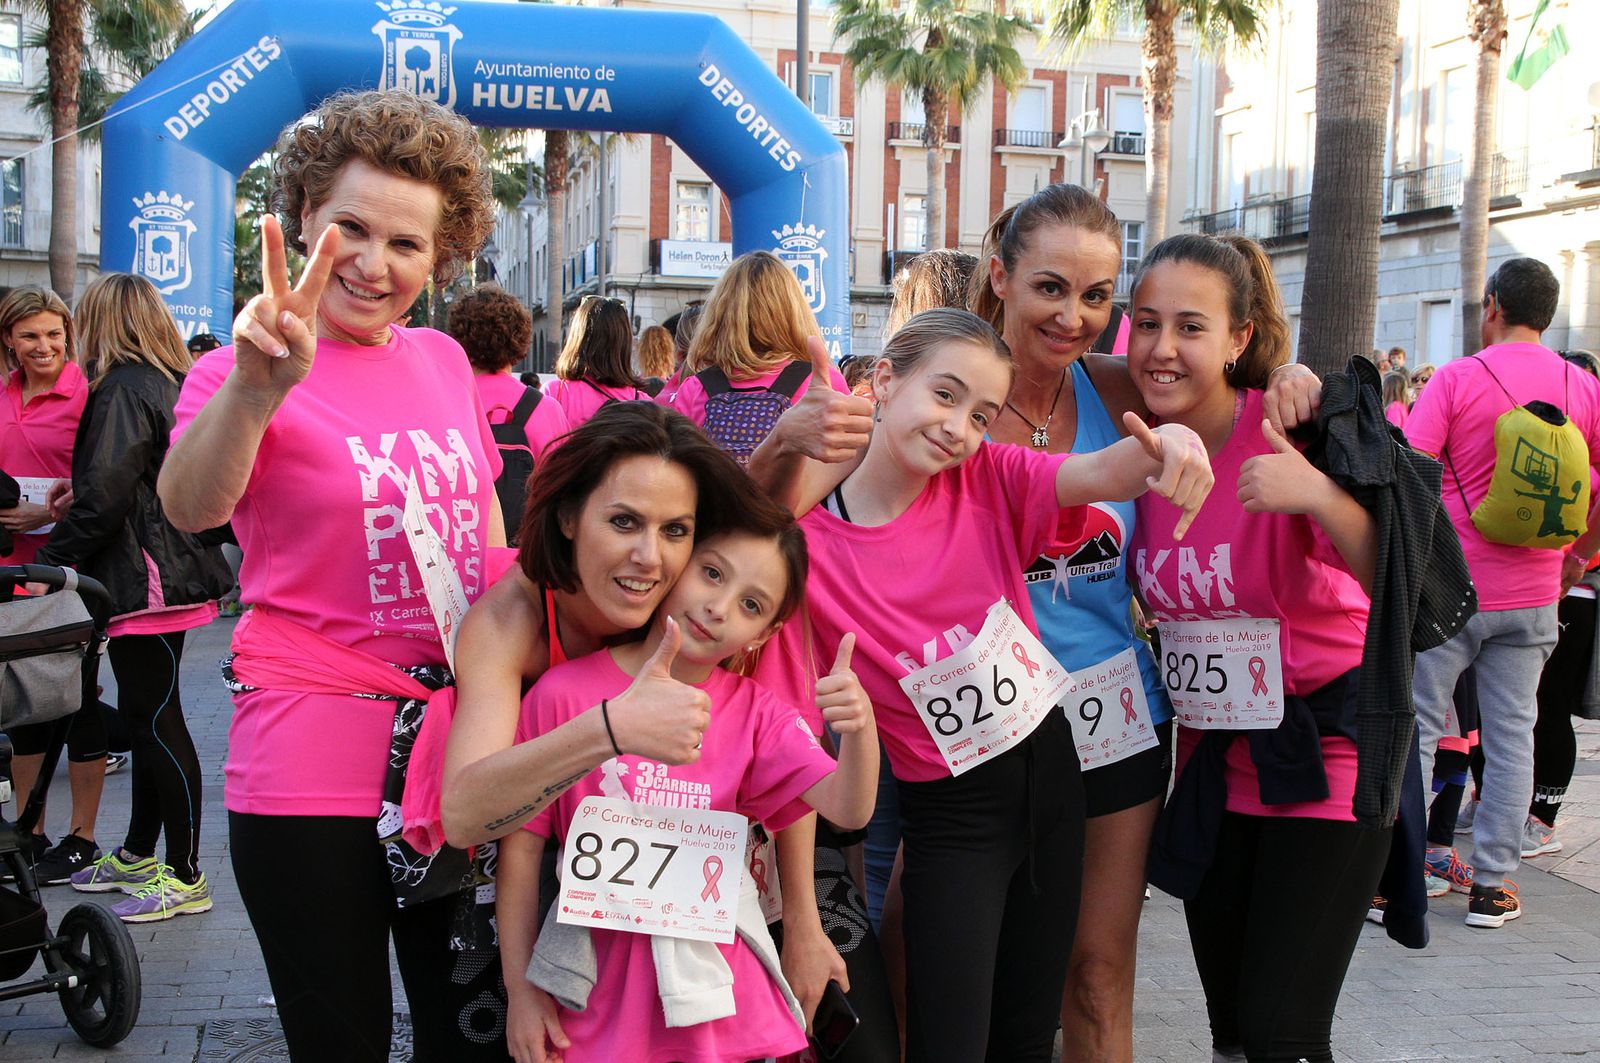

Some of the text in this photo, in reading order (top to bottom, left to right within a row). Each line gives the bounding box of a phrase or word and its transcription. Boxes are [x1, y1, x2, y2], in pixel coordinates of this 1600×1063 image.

[474, 59, 616, 81] Ayuntamiento de
[163, 35, 282, 140] DEPORTES
[472, 82, 612, 112] HUELVA
[698, 64, 802, 172] DEPORTES
[668, 250, 720, 261] Helen Doron
[200, 305, 213, 318] de
[832, 324, 842, 336] de
[345, 428, 478, 502] KM
[1025, 558, 1118, 582] UB Ultra Trail
[1086, 570, 1117, 584] HUELVA
[1136, 543, 1236, 610] KM
[390, 606, 434, 620] Carre
[1172, 631, 1202, 644] Carrera
[1205, 632, 1218, 644] de
[1223, 632, 1234, 642] la
[1238, 630, 1272, 644] Mujer
[930, 662, 976, 686] Carrera
[978, 649, 990, 663] de
[986, 639, 996, 650] la
[992, 614, 1010, 640] Mujer
[1226, 644, 1272, 654] Huelva 2019
[1080, 678, 1094, 690] de
[1097, 674, 1107, 685] la
[1109, 662, 1134, 680] Mujer
[1121, 672, 1136, 685] 2019
[1166, 651, 1228, 694] 825
[926, 664, 1017, 736] 826
[634, 786, 648, 798] DE
[652, 776, 711, 796] CARRERA
[1534, 784, 1568, 804] PU
[634, 789, 712, 810] LA MUJER
[601, 808, 654, 828] Carrera
[658, 818, 676, 832] de
[680, 820, 692, 834] la
[697, 824, 738, 840] Mujer
[680, 836, 710, 850] Huelva
[712, 842, 736, 852] 2019
[570, 832, 680, 890] 827
